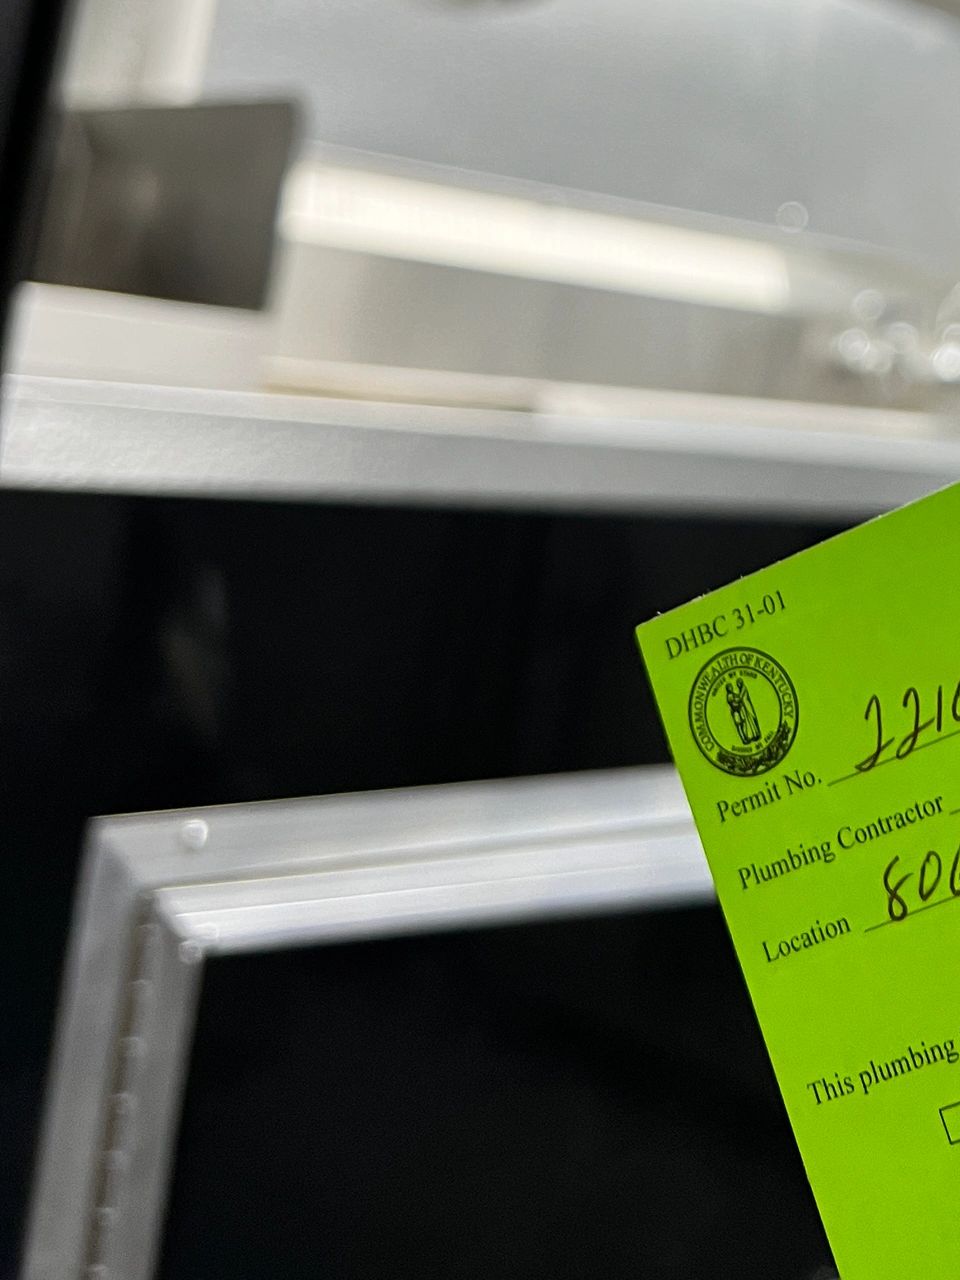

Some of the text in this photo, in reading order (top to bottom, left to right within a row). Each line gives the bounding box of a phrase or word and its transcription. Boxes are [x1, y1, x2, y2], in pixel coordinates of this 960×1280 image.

[665, 590, 785, 660] DHBC 31-01
[755, 656, 794, 719] KENTUCKY
[716, 770, 822, 823] Permit No.
[738, 796, 943, 890] Plumbing Contractor
[762, 917, 851, 963] Location
[806, 1072, 855, 1106] This
[859, 1038, 960, 1094] plumbing
